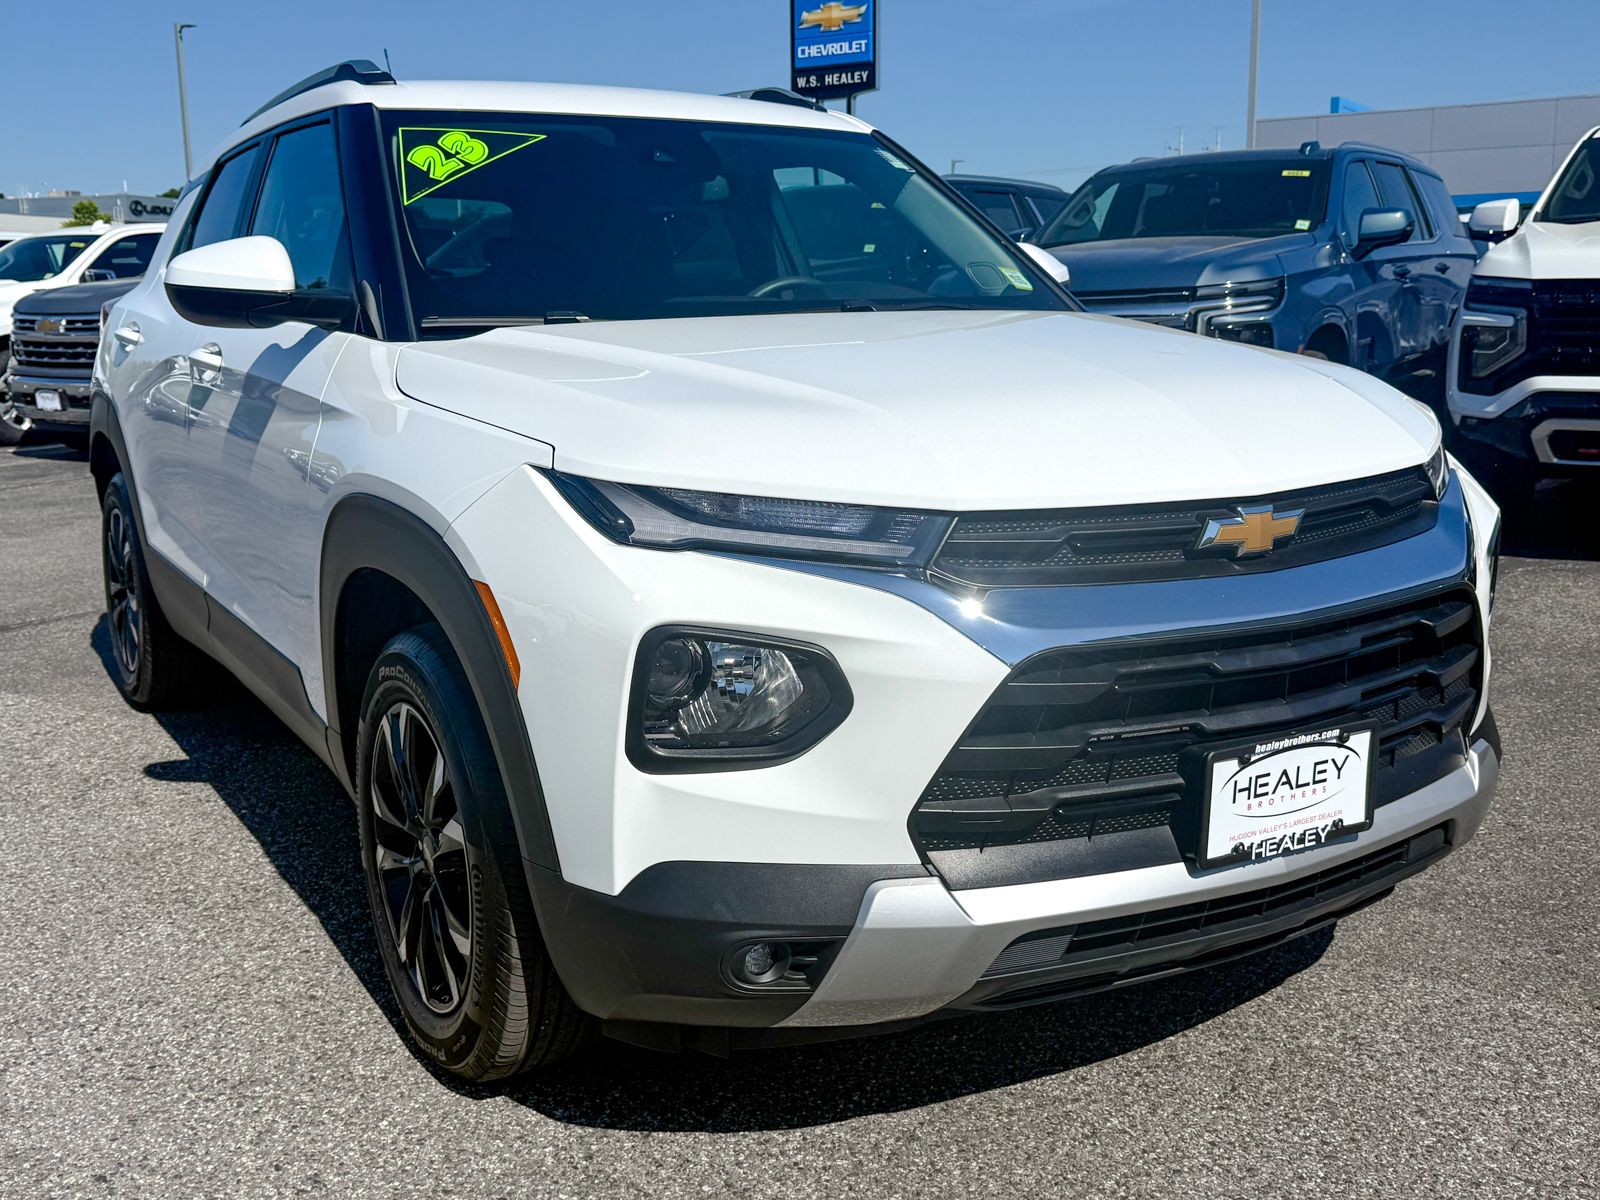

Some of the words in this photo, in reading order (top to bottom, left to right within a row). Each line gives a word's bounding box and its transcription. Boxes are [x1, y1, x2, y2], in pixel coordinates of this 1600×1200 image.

[797, 40, 868, 59] CHEVROLET
[797, 75, 821, 89] W.S.
[824, 70, 869, 87] HEALEY
[406, 131, 489, 181] 23
[1254, 728, 1341, 754] healeybrothers.com
[1231, 755, 1350, 804] HEALEY
[1246, 786, 1328, 811] BROTHERS
[1229, 829, 1257, 842] HUDSON
[1258, 822, 1288, 835] VALLEY'S
[1288, 815, 1317, 828] LARGEST
[1317, 809, 1343, 821] DEALER
[1251, 825, 1331, 860] HEALEY
